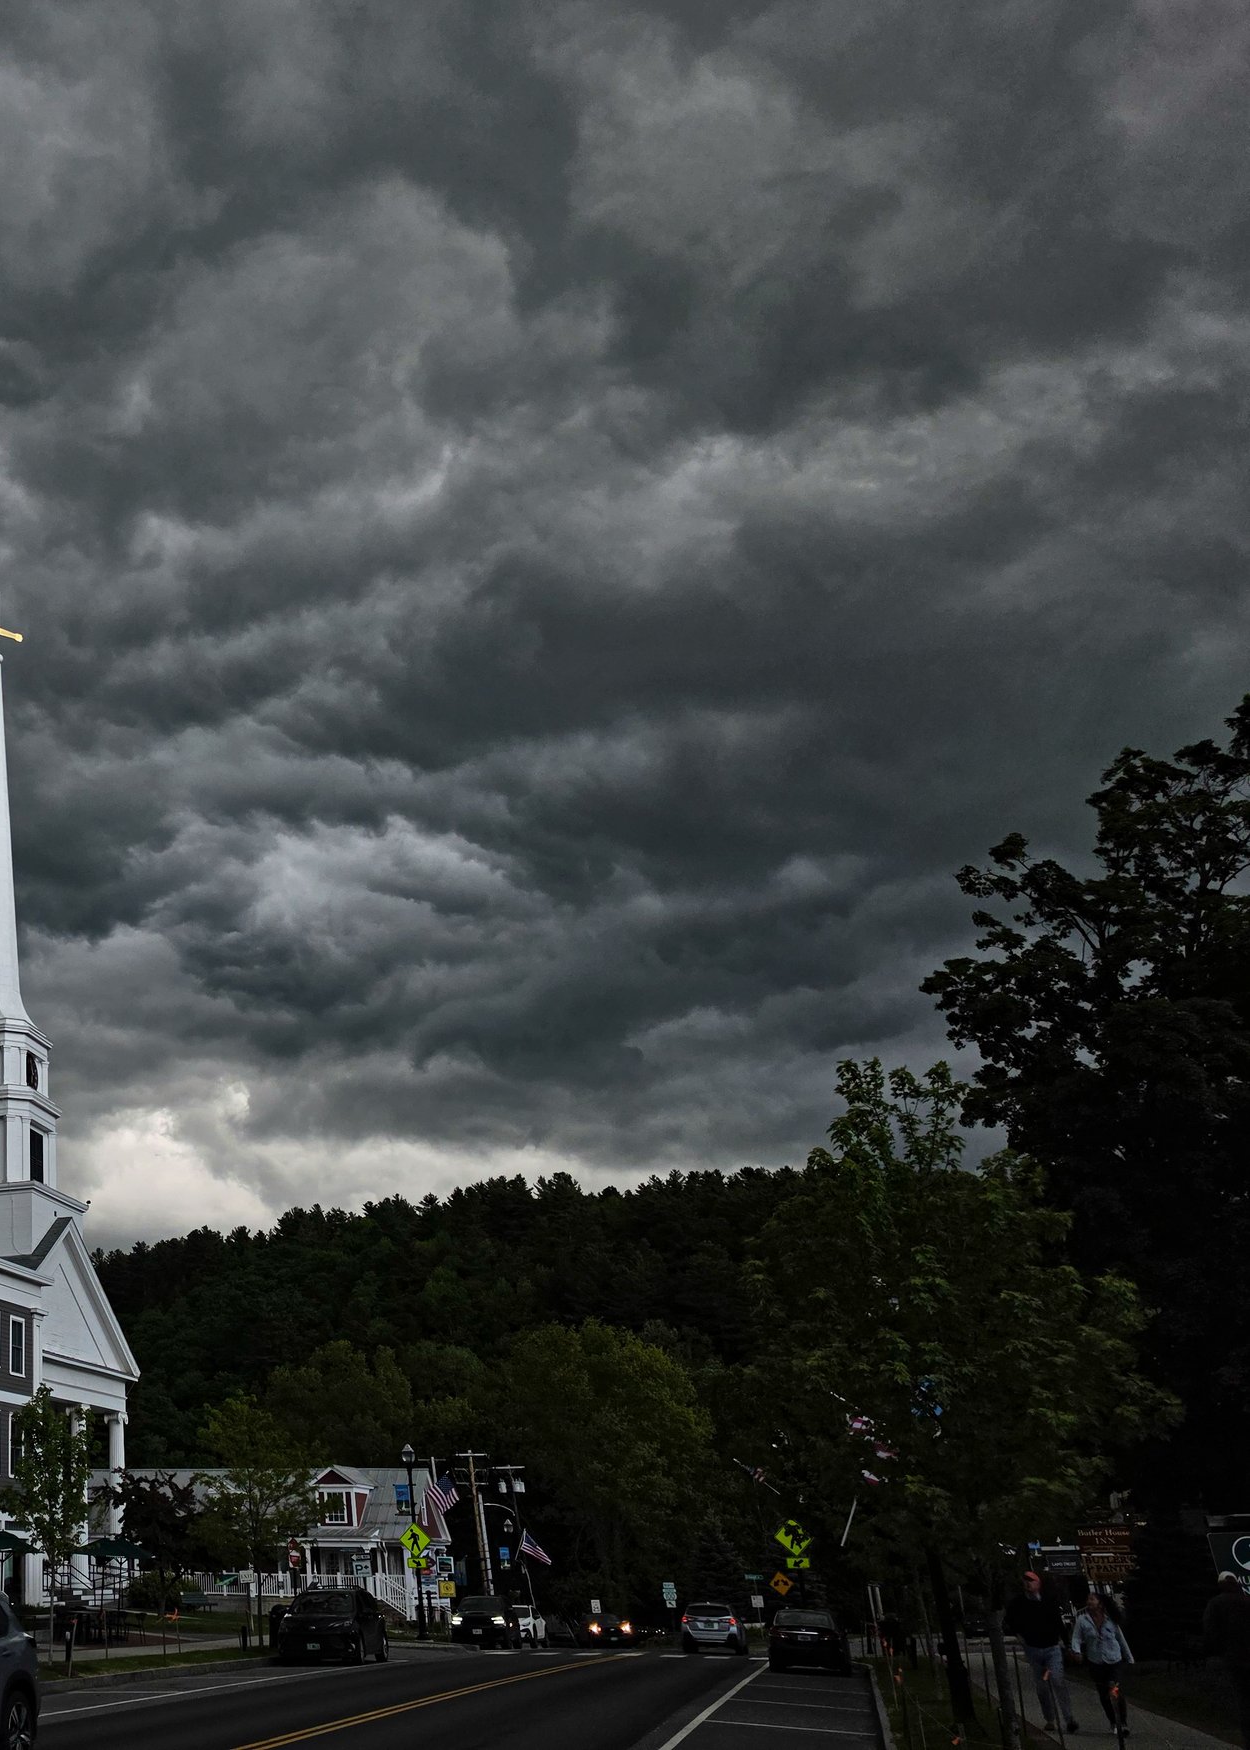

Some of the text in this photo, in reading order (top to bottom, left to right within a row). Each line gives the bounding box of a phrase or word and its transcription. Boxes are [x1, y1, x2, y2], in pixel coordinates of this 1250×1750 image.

[1077, 1528, 1131, 1537] Butler House
[1095, 1537, 1116, 1545] INN
[355, 1564, 363, 1575] P
